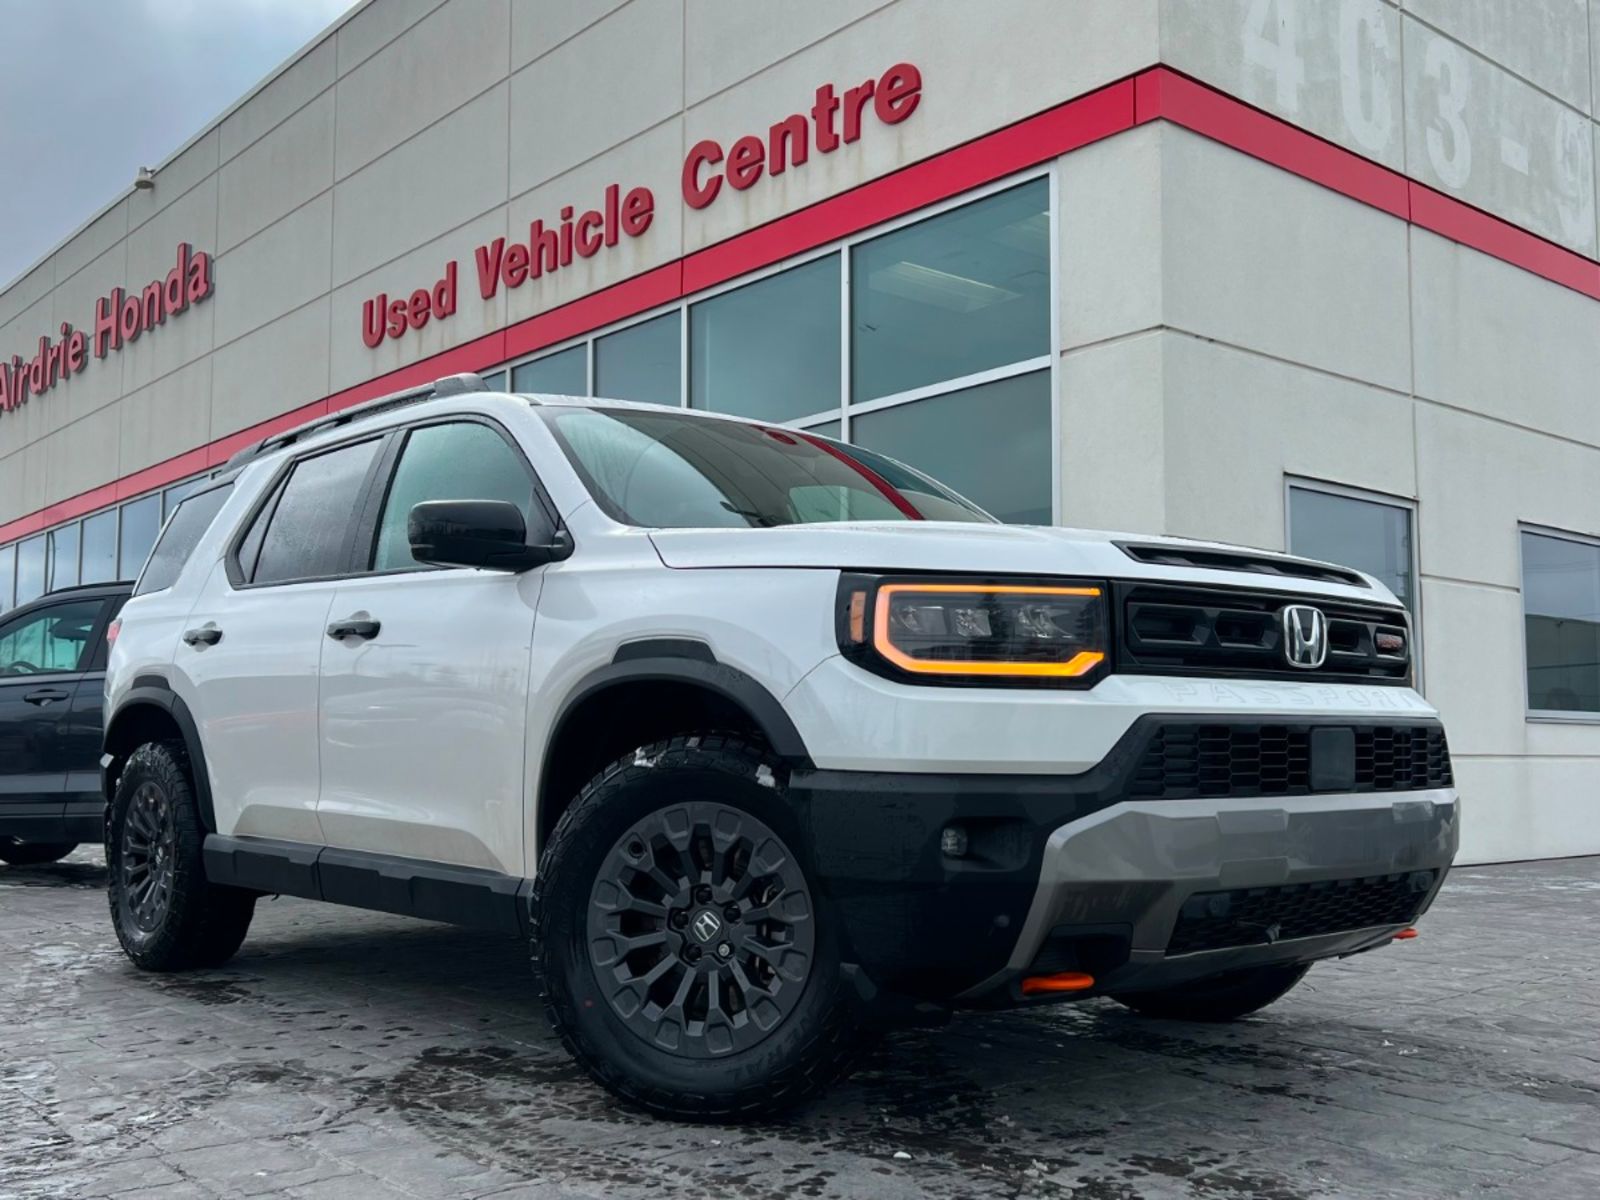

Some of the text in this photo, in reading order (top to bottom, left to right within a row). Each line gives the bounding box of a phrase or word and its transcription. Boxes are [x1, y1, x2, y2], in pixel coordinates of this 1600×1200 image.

[95, 242, 212, 358] Honda
[362, 62, 922, 348] Used Vehicle Centre
